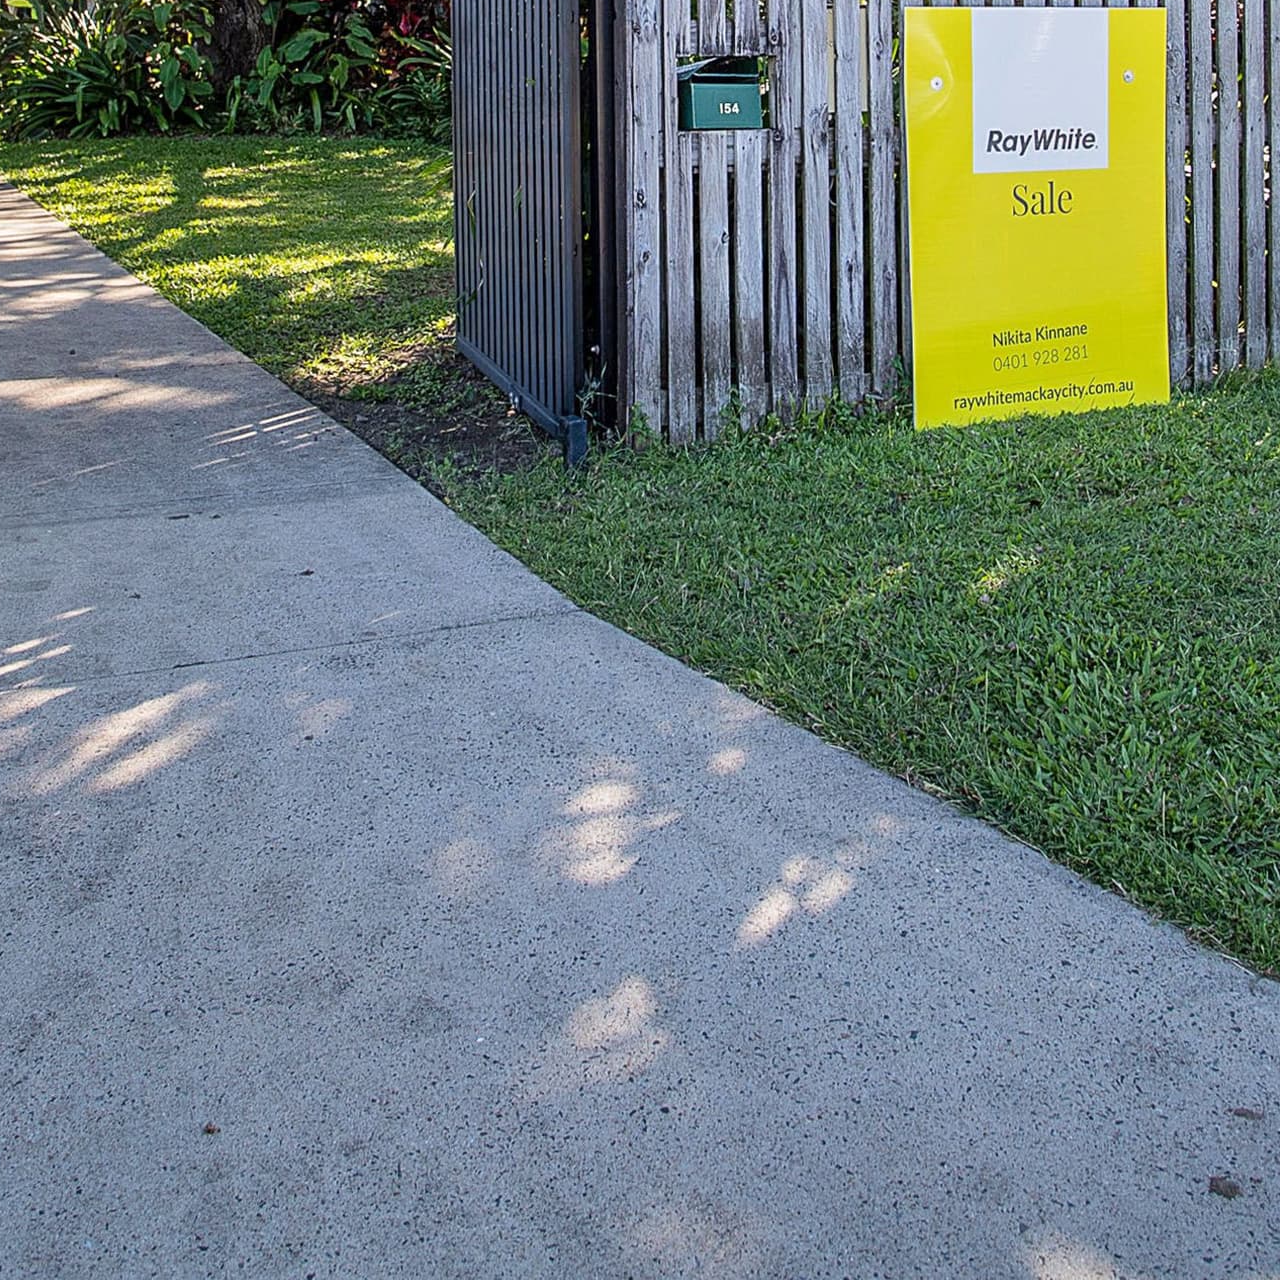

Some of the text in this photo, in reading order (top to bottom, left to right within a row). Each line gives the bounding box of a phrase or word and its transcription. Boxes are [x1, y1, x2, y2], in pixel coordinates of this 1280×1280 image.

[719, 103, 740, 114] 154
[1012, 181, 1073, 217] Sale
[992, 323, 1088, 347] Nikita Kinnane
[993, 345, 1089, 371] 0401 928 281
[953, 380, 1134, 410] raywhitemackaycity.com.au
